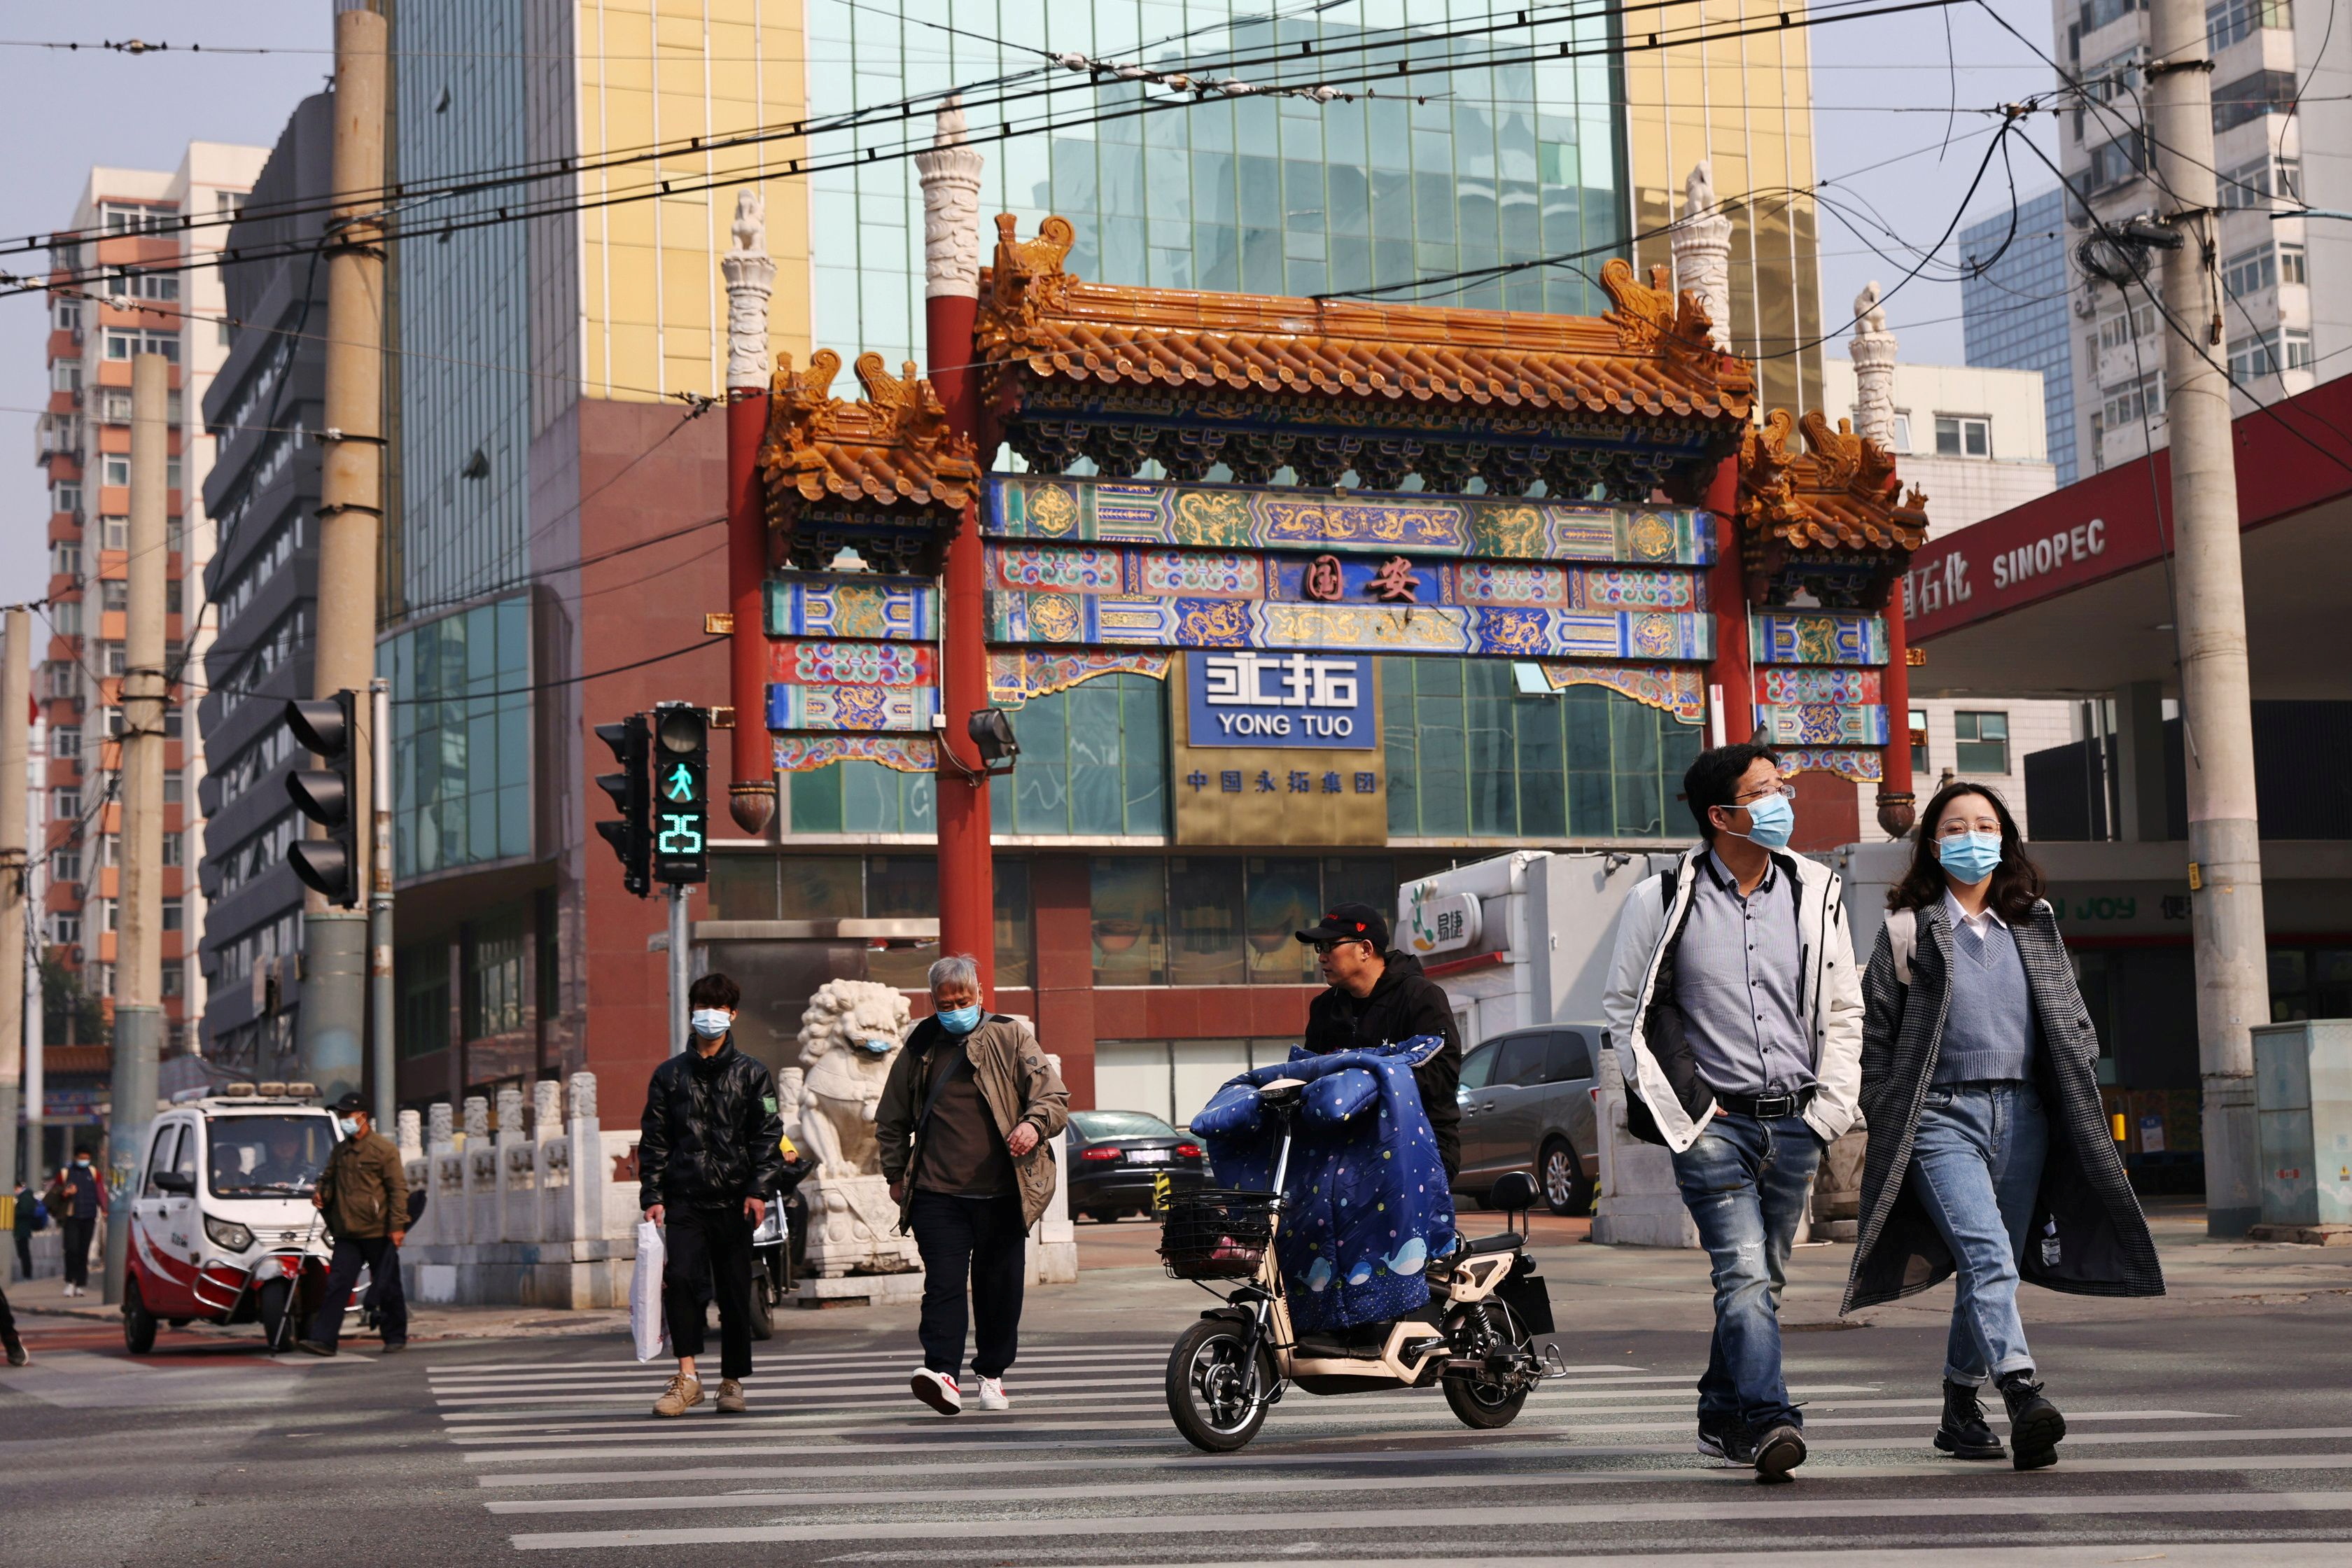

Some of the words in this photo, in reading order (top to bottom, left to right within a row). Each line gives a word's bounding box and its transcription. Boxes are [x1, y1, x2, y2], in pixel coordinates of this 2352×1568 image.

[1992, 519, 2105, 589] SINOPEC
[1218, 713, 1290, 735] YONG
[1301, 715, 1353, 736] TUO
[1187, 770, 1376, 794] 中国永拓集团
[659, 815, 701, 853] 25
[2075, 896, 2136, 920] JOY
[1437, 909, 1464, 942] 易捷
